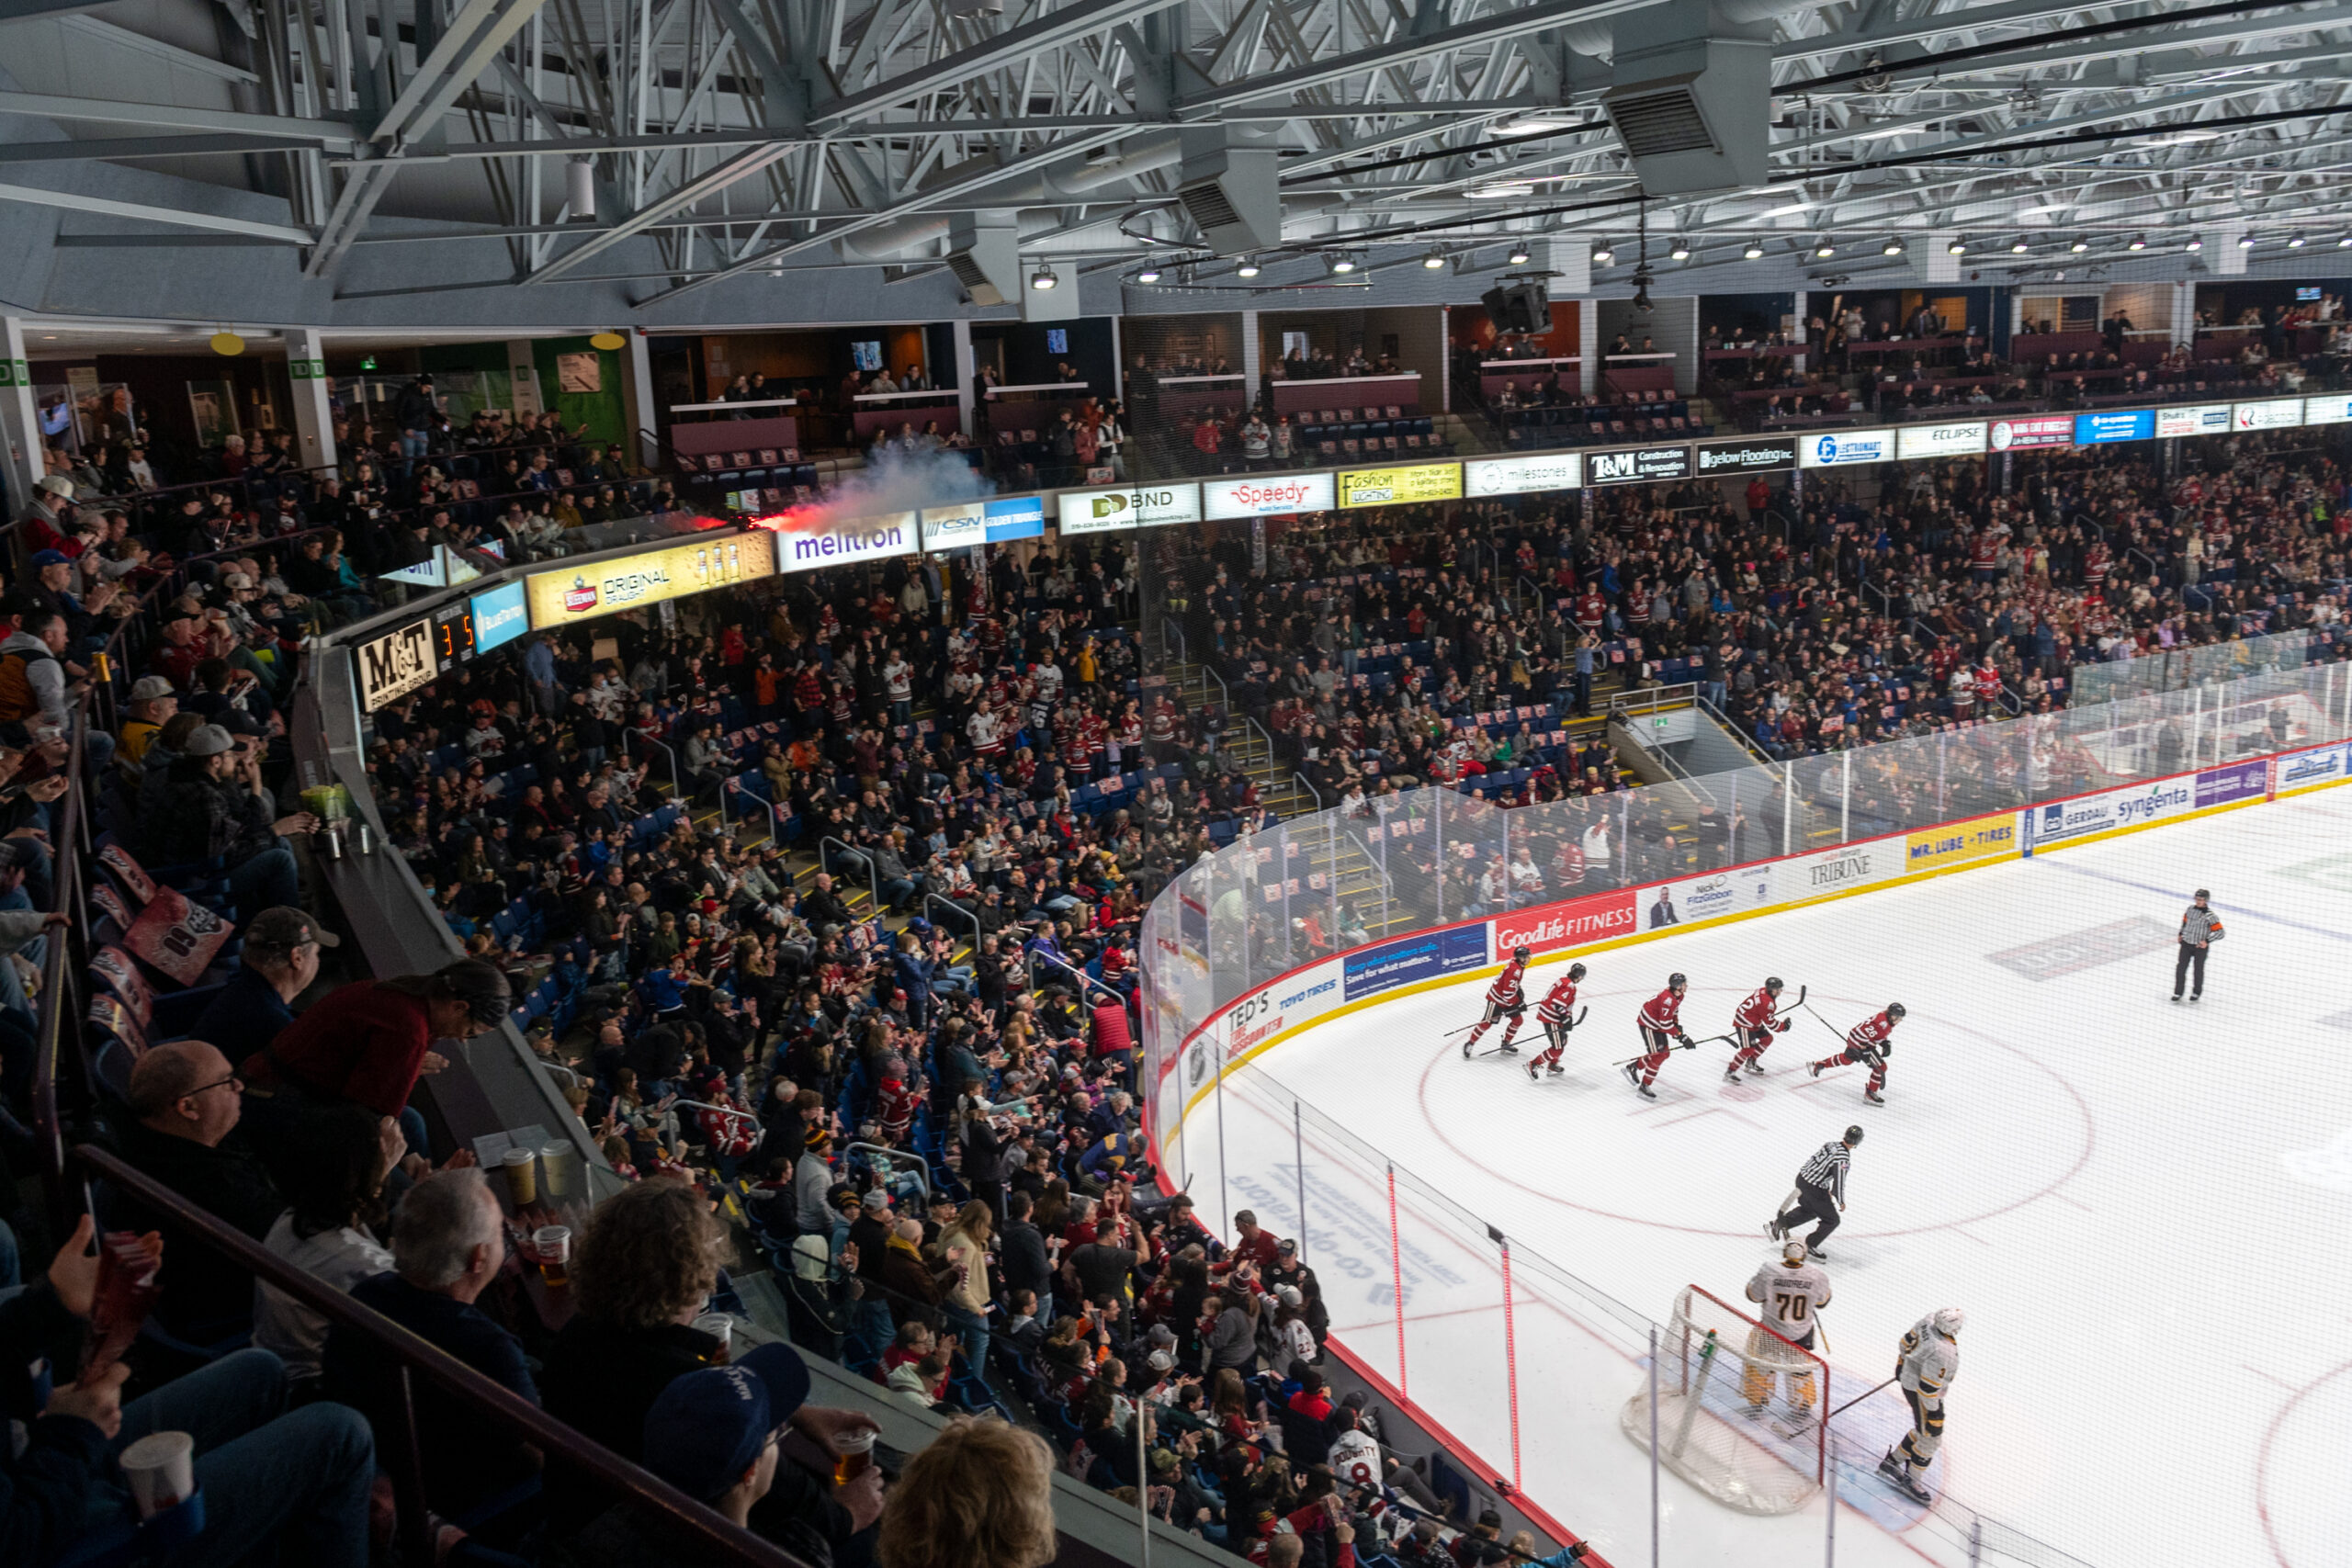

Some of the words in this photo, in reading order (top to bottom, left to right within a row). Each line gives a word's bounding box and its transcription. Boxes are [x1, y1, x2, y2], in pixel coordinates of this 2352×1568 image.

[293, 364, 309, 378] TD
[1931, 425, 1982, 441] ECLIPSE
[1638, 449, 1684, 461] Construction
[1700, 450, 1740, 469] Bigelow
[1741, 448, 1781, 464] Flooring
[1781, 449, 1793, 459] Inc.
[1507, 467, 1566, 481] milestones
[1590, 453, 1635, 479] T&M
[1638, 464, 1645, 473] &
[1645, 461, 1685, 472] Renovation
[1230, 482, 1311, 506] Speedy
[1342, 472, 1394, 506] Fashion
[1354, 490, 1390, 501] LIGHTING
[1130, 491, 1173, 510] BND
[942, 515, 981, 530] CSN
[603, 568, 670, 595] ORIGINAL
[565, 591, 597, 608] SLEEMAN
[604, 589, 647, 605] DRAUGHT
[441, 624, 454, 657] 3
[463, 615, 474, 647] 5
[364, 622, 427, 694] M&T
[370, 682, 407, 707] PRINTING
[408, 670, 434, 692] GROUP
[2119, 786, 2188, 822] syngenta
[2066, 806, 2109, 826] GERDAU
[1910, 844, 1934, 860] MR.
[1936, 835, 1963, 853] LUBE
[1977, 826, 2012, 844] TIRES
[1809, 855, 1871, 886] TRIBUNE
[1686, 890, 1734, 906] FitzGibbon
[1695, 883, 1714, 894] Nick
[1498, 917, 1566, 950] GoodLife
[1566, 907, 1634, 938] FITNESS
[1346, 962, 1367, 975] Keep
[1367, 956, 1386, 967] what
[1387, 949, 1419, 961] matters
[1346, 973, 1364, 985] Save
[1365, 969, 1378, 980] for
[1378, 962, 1398, 975] what
[1398, 955, 1433, 968] matters.
[1279, 987, 1306, 1010] TOYO
[1306, 978, 1337, 1002] TIRES
[1561, 991, 1570, 999] 4
[1227, 990, 1270, 1032] TED'S
[1229, 1023, 1249, 1043] TIRE
[1864, 1025, 1879, 1038] 26
[715, 1129, 724, 1140] 3
[1227, 1174, 1375, 1280] co-operators
[1775, 1292, 1808, 1321] 70
[1938, 1367, 1946, 1380] 3
[1333, 1445, 1377, 1466] DOUGHTY
[1351, 1461, 1372, 1486] 8
